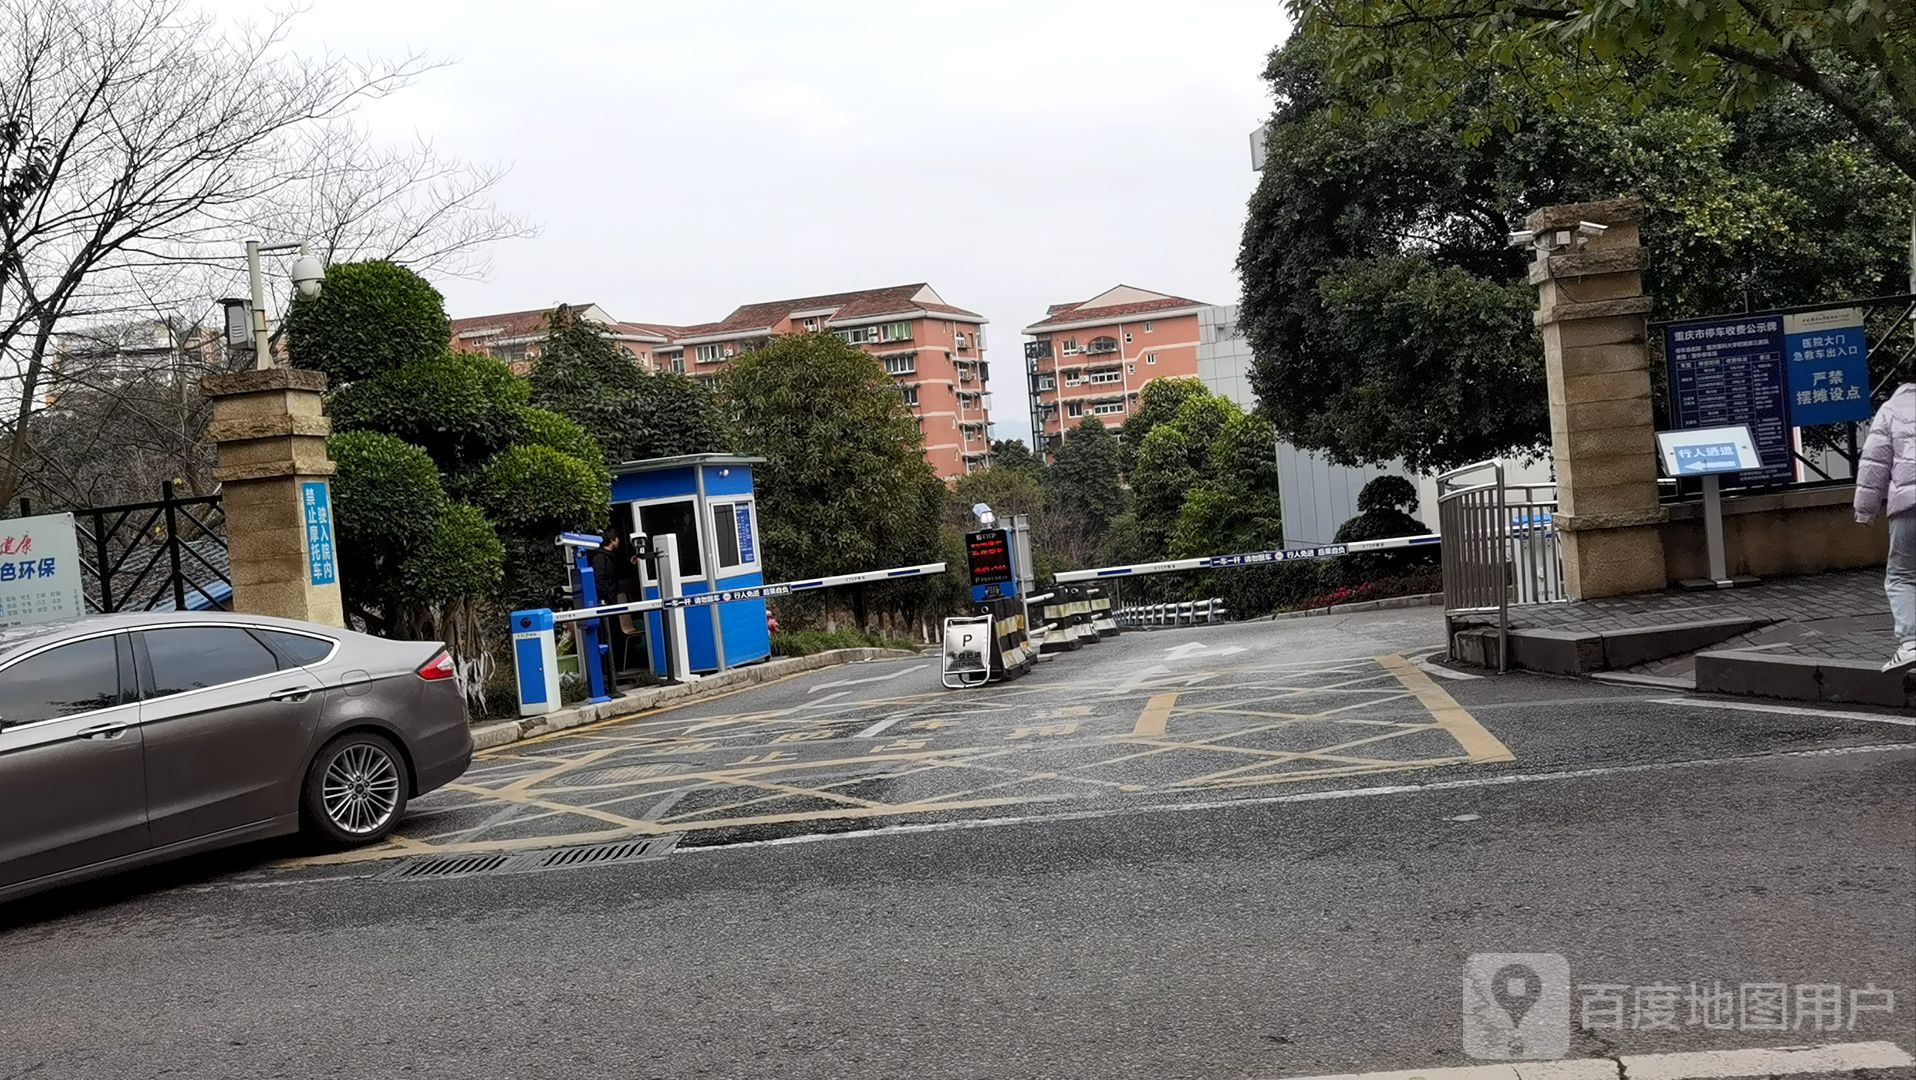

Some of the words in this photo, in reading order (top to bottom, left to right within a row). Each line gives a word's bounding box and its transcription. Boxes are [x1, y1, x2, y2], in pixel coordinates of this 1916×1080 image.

[1674, 322, 1777, 341] 重庆市停车收费公示牌
[1802, 334, 1845, 348] 医院大门
[1793, 346, 1857, 361] 急救车出入口
[1812, 370, 1843, 386] 严禁
[1796, 385, 1861, 405] 摆摊设点
[1678, 445, 1734, 458] 行人通道
[304, 487, 322, 580] 禁止摩托车
[317, 506, 332, 579] 驶入院内
[0, 557, 55, 581] 色环保
[1213, 557, 1240, 565] 一车一杆
[962, 634, 973, 647] P
